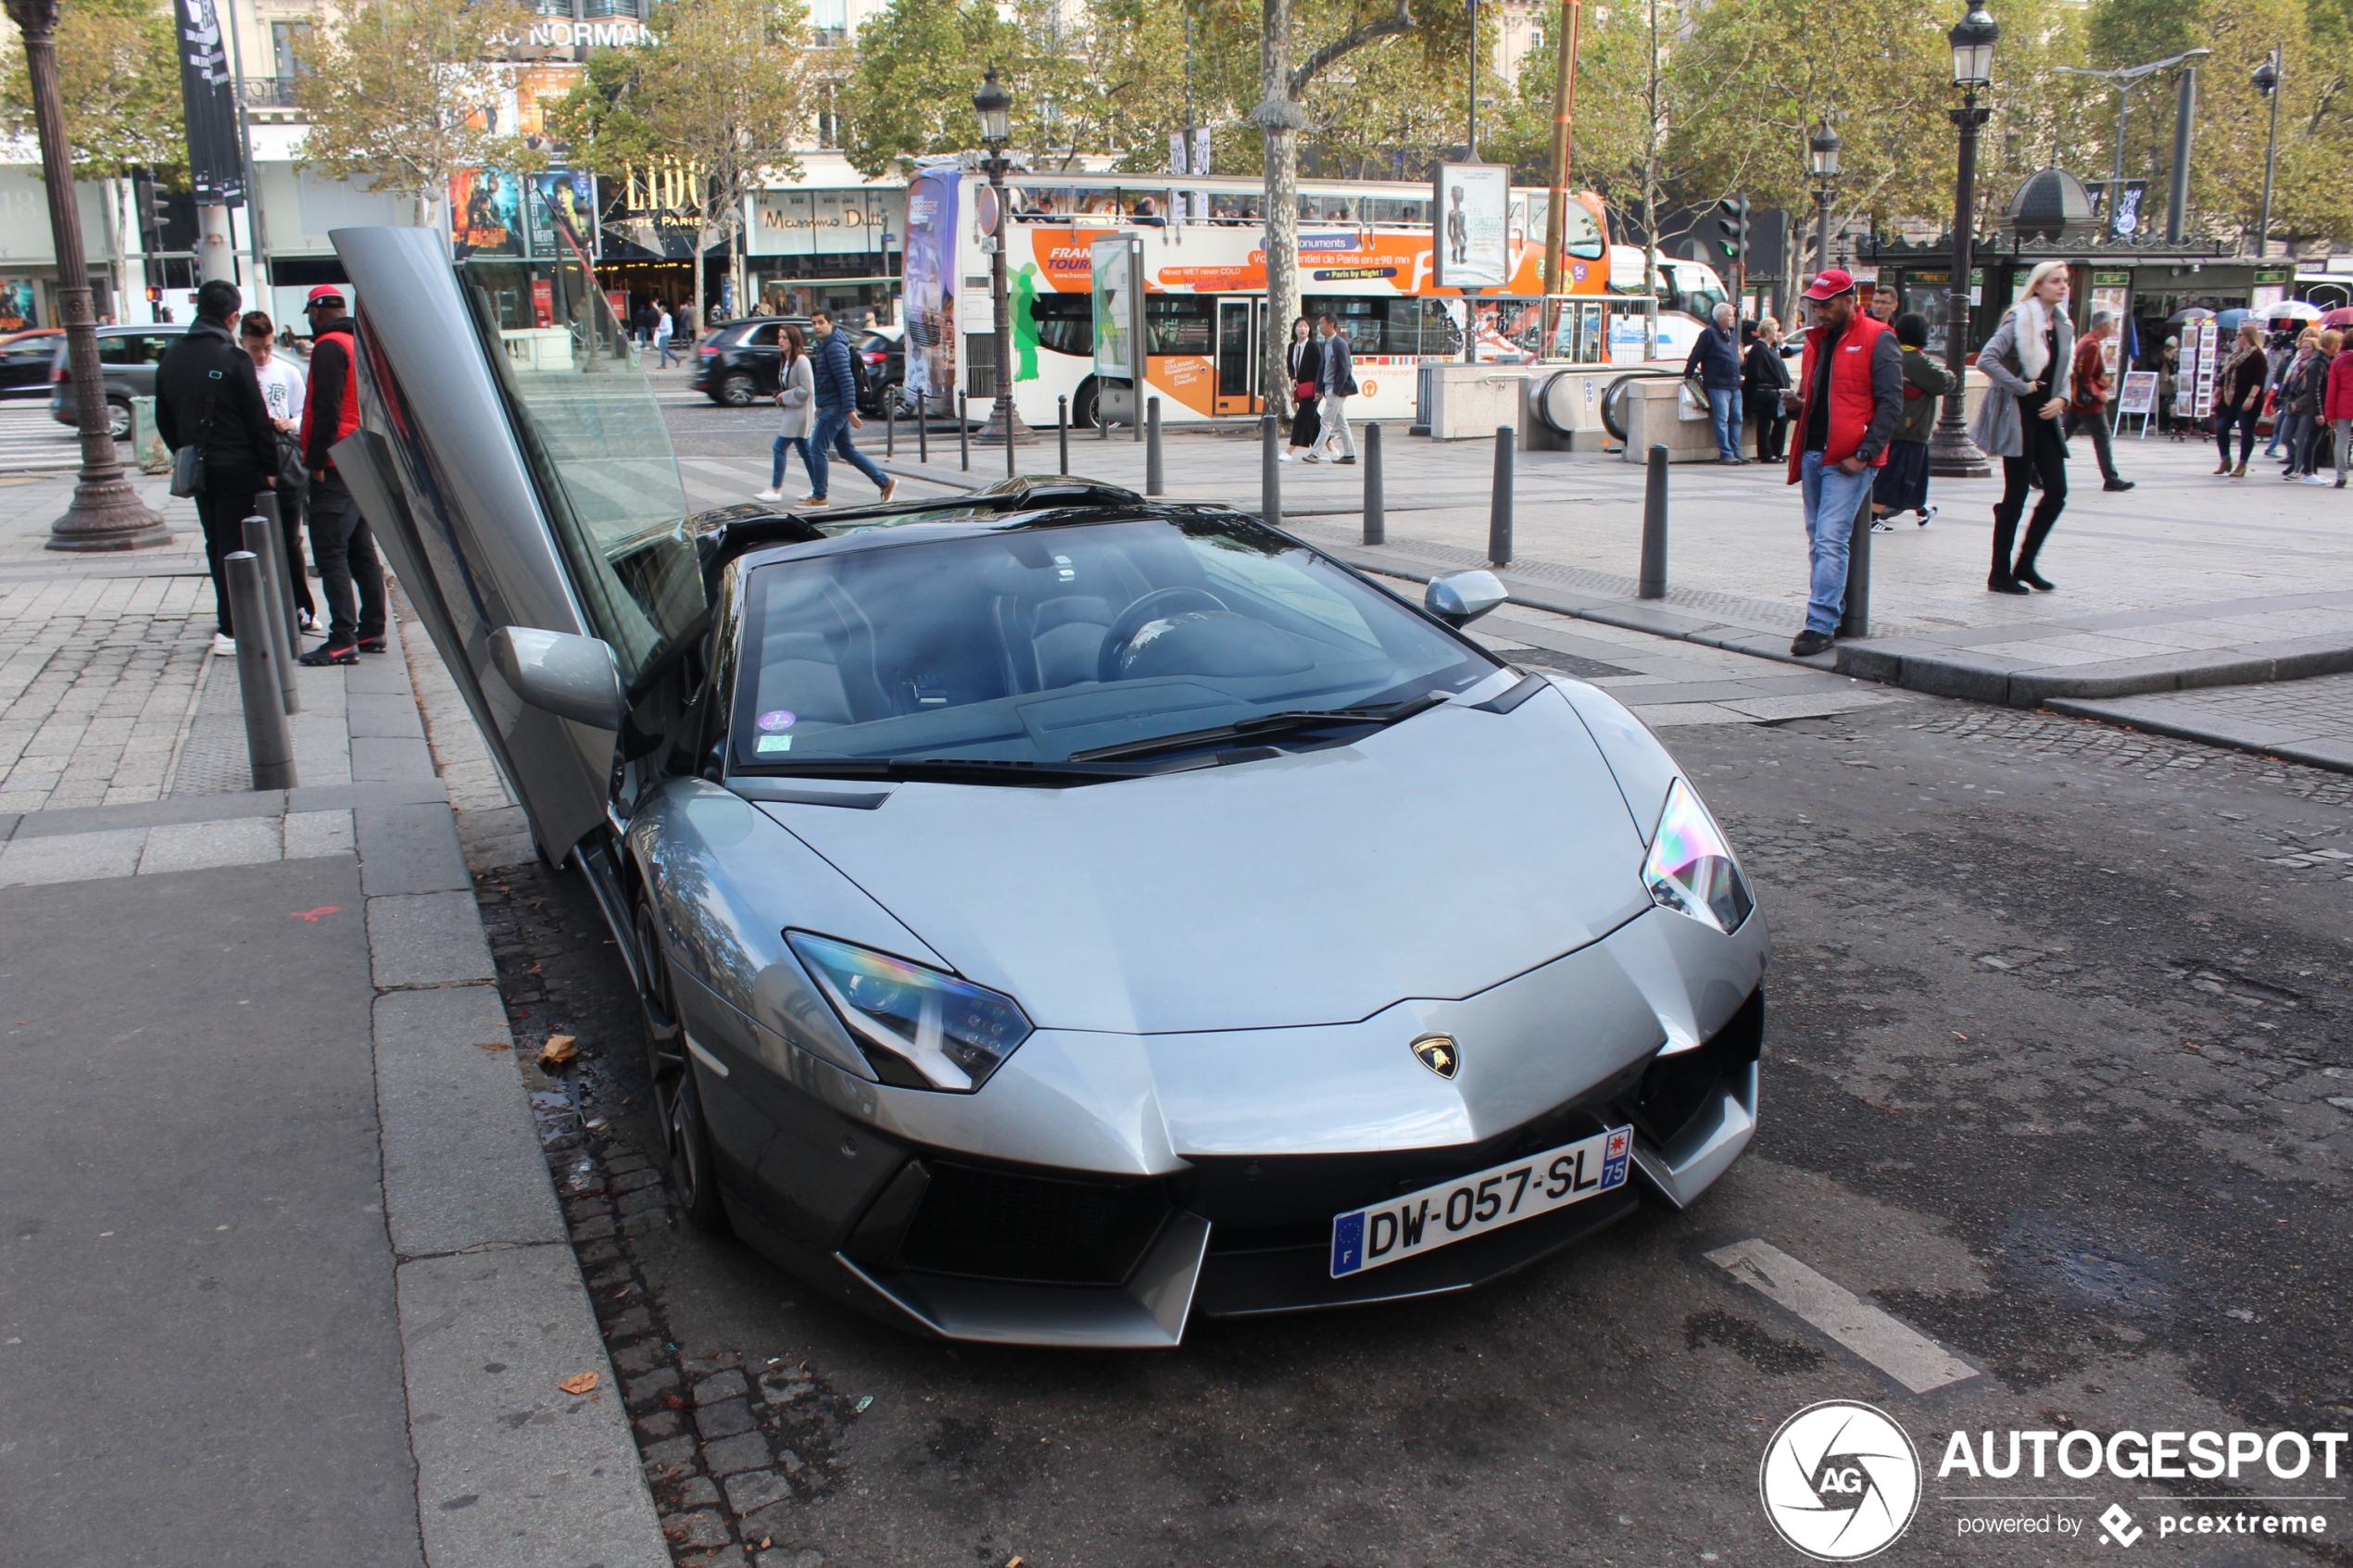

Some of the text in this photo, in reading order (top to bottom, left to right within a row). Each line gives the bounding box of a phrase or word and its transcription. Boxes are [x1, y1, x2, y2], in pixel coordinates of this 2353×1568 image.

[529, 22, 660, 47] NORMAN
[765, 208, 884, 230] Massimo Dutt
[1298, 238, 1346, 248] onuments
[1050, 247, 1091, 258] FRAN
[1253, 253, 1266, 264] Vo
[1297, 254, 1321, 264] entiel
[1323, 254, 1335, 264] de
[1337, 254, 1360, 264] Paris
[1361, 257, 1374, 265] en
[1395, 257, 1410, 265] mn
[1220, 267, 1241, 275] COLD
[1331, 270, 1350, 278] Paris
[1350, 270, 1360, 280] by
[1361, 269, 1379, 280] Night
[1604, 1160, 1626, 1185] 75
[1367, 1149, 1599, 1260] DW-057-SL
[1343, 1250, 1353, 1264] F
